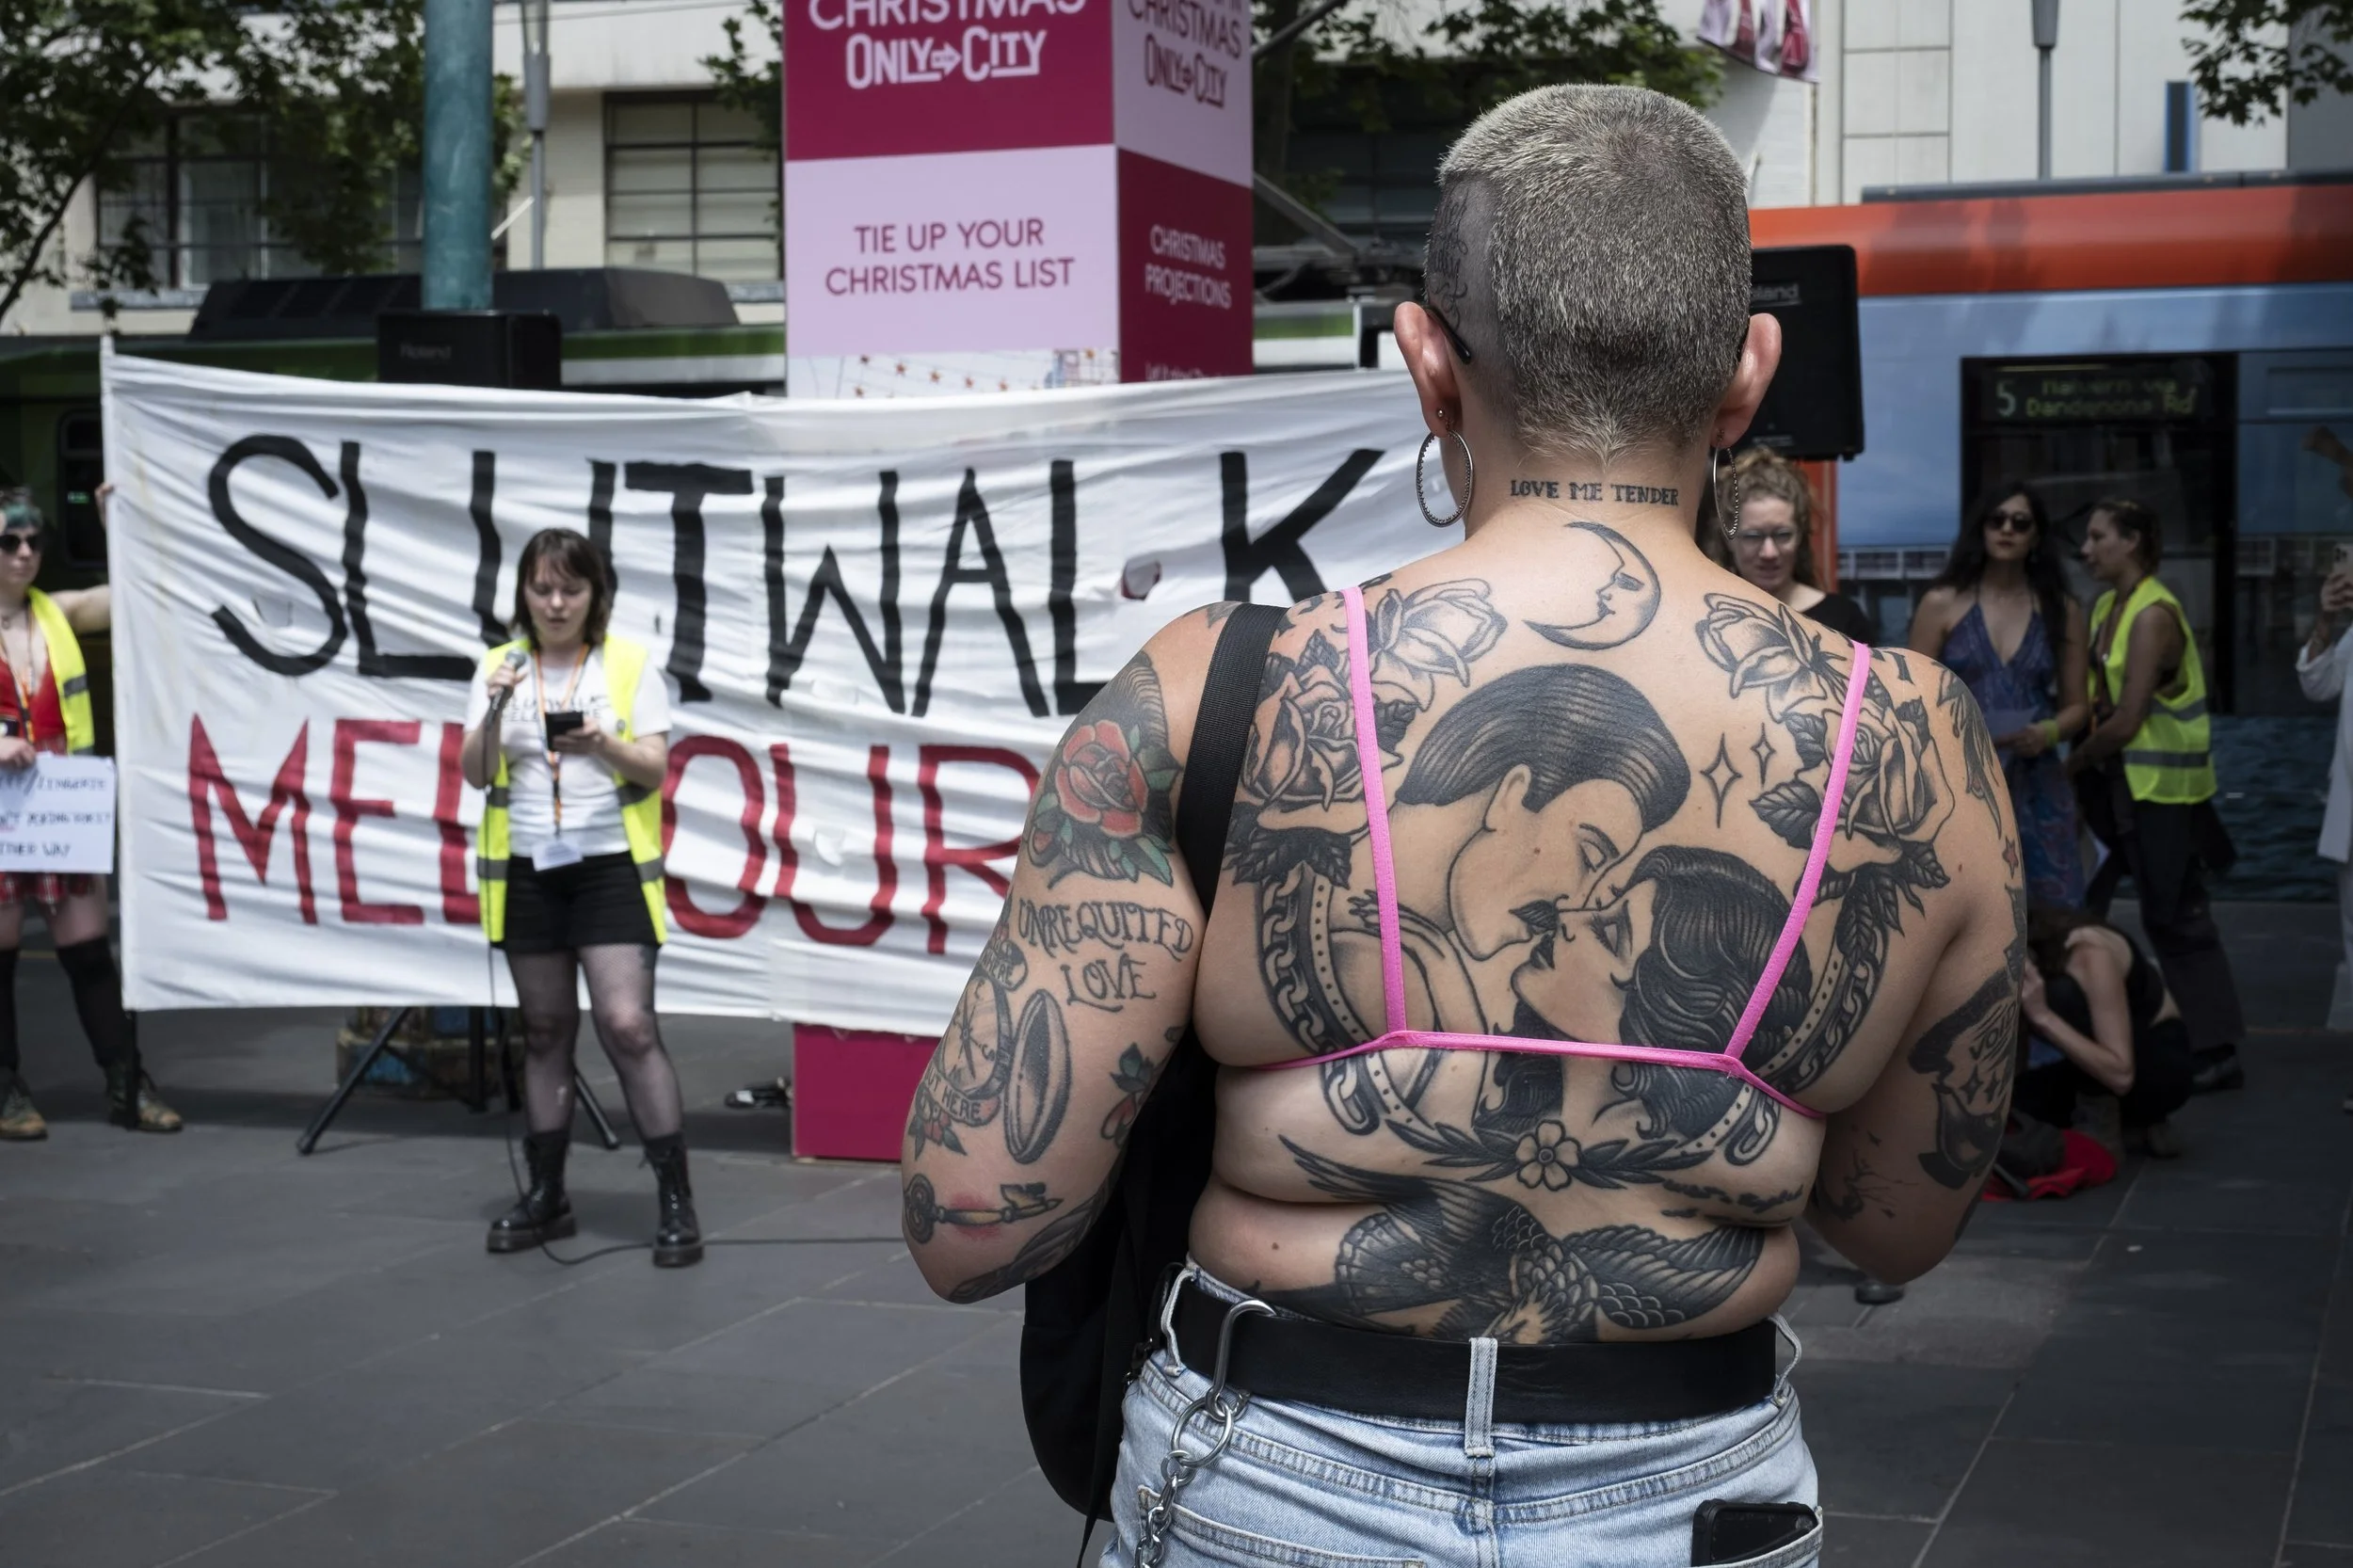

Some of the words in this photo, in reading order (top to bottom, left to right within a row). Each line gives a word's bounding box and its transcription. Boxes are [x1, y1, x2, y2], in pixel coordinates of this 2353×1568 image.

[846, 33, 942, 89] ONLY
[962, 25, 1048, 82] CITY
[854, 223, 896, 254] TIE
[906, 222, 947, 251] UP
[957, 217, 1045, 248] YOUR
[1149, 224, 1226, 270] CHRISTMAS
[824, 261, 1004, 296] CHRISTMAS
[1015, 257, 1076, 289] LIST
[1144, 263, 1233, 311] PROJECTIONS
[1995, 380, 2018, 418] 5
[1510, 479, 1560, 499] LOVE
[1568, 482, 1604, 501] ME
[1610, 484, 1679, 506] TENDER
[188, 712, 1042, 955] MELOUR
[1017, 898, 1194, 963] UNREQUITED
[1060, 952, 1157, 1013] LOVE
